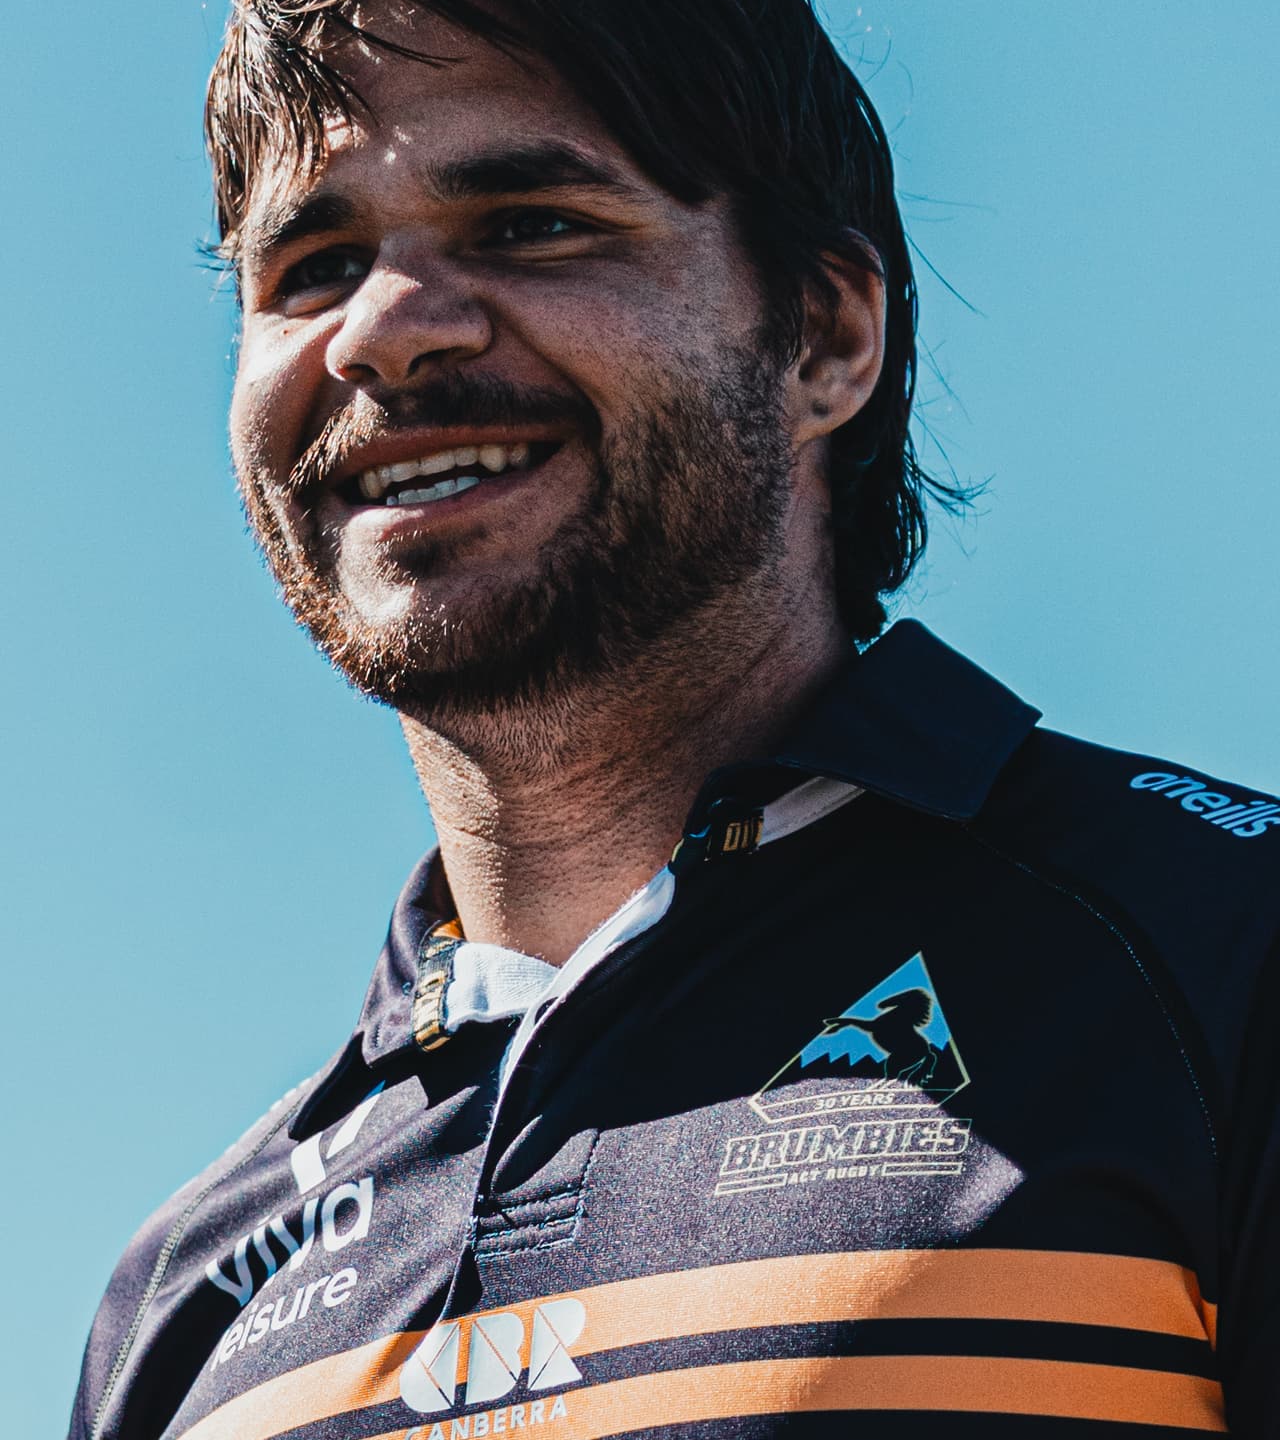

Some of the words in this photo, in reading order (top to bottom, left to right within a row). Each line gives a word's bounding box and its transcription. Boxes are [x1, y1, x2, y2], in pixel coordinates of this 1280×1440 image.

[815, 1098, 836, 1111] 30
[841, 1093, 896, 1107] YEARS
[719, 1117, 972, 1177] BRUMBIES
[788, 1169, 821, 1186] ACT
[826, 1163, 880, 1180] RUGBY
[205, 1175, 375, 1309] viva
